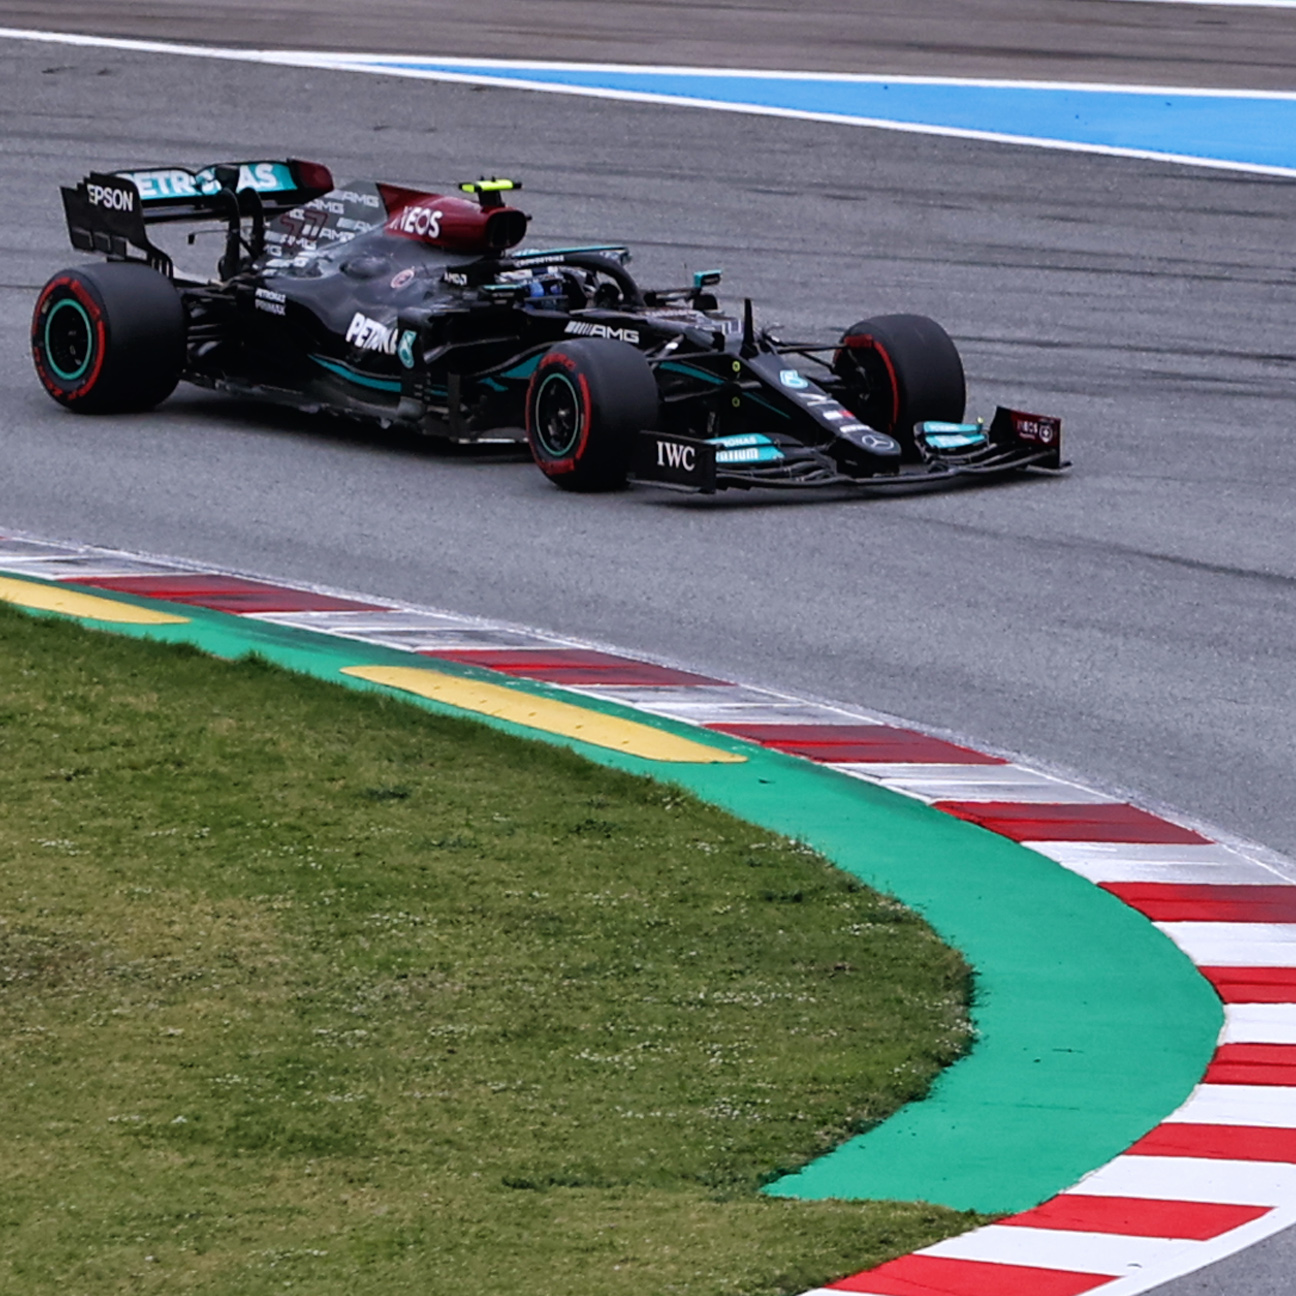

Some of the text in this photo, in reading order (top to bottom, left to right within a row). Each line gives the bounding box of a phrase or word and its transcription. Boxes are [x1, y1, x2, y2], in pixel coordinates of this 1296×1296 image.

[86, 183, 134, 212] EPSON
[589, 323, 640, 345] AMG
[656, 440, 696, 472] IWC
